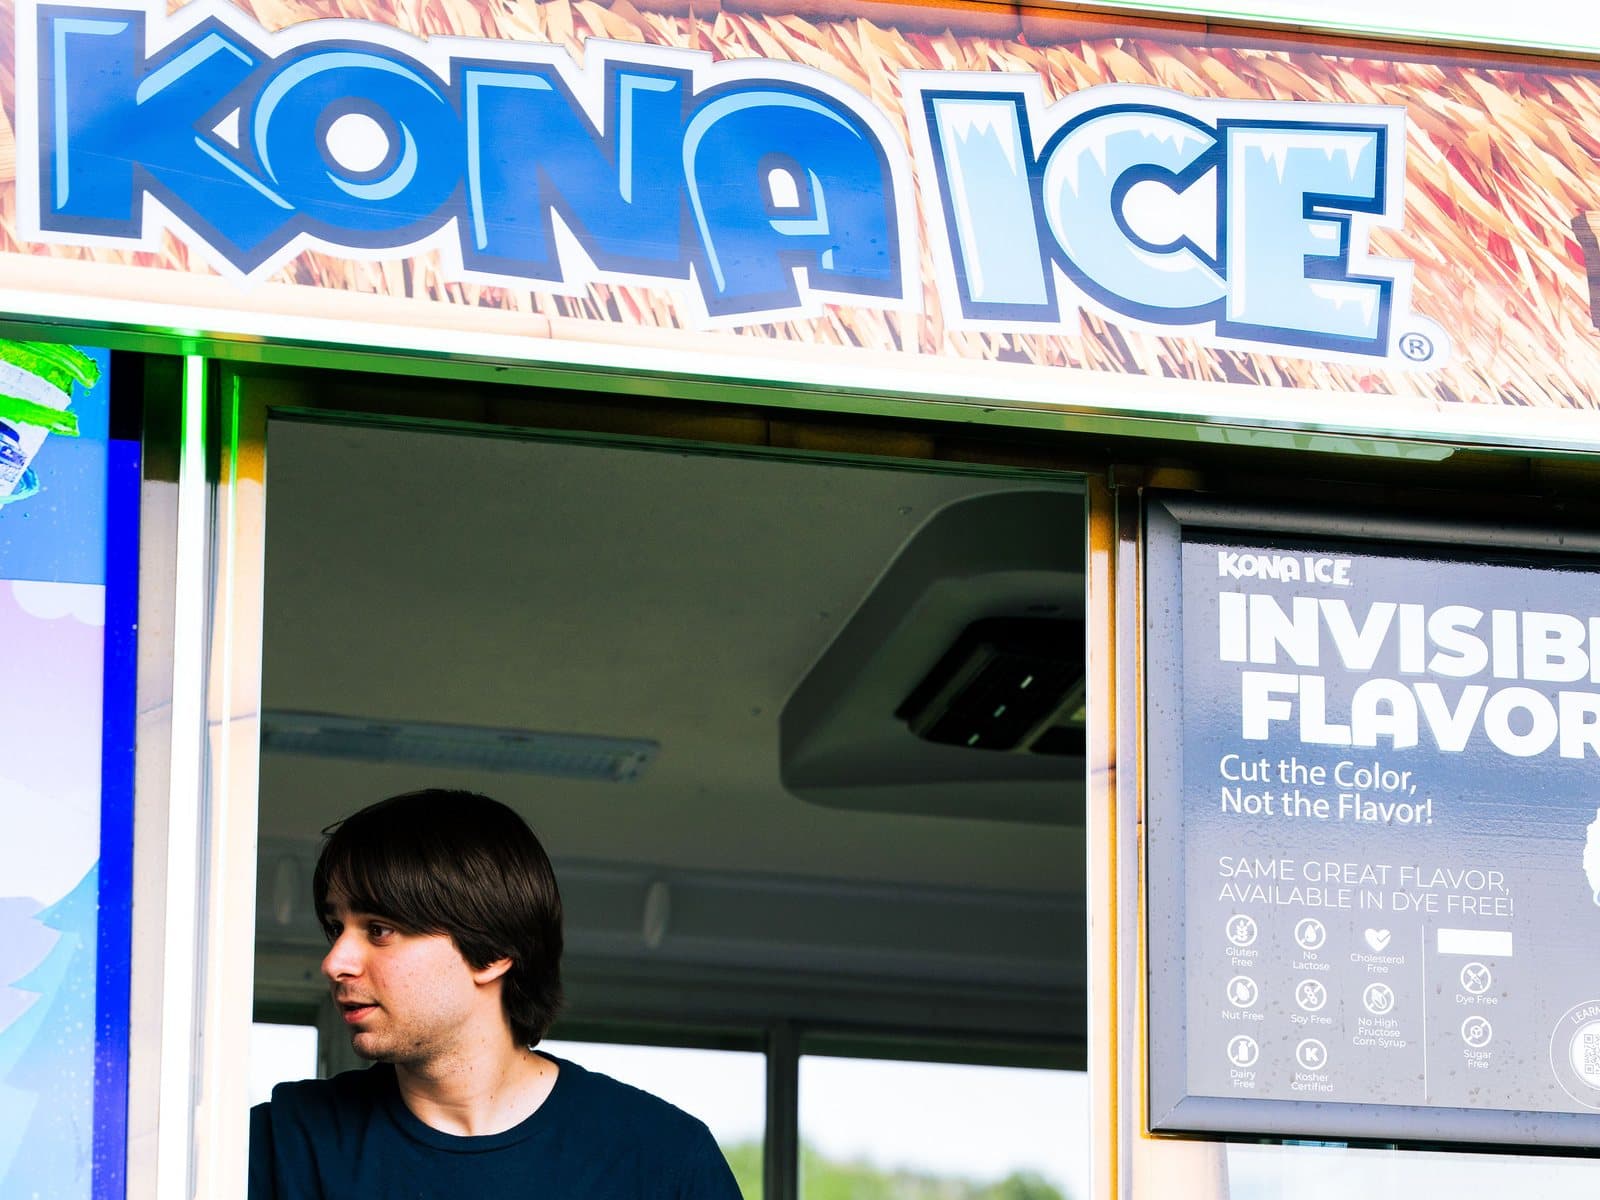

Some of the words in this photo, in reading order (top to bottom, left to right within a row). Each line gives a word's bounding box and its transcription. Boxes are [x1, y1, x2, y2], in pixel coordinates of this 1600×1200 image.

[35, 3, 904, 319] KONA
[921, 89, 1395, 358] ICE
[1218, 551, 1300, 582] KONA
[1304, 557, 1352, 585] ICE
[1219, 591, 1600, 683] INVISIB
[1220, 754, 1271, 783] Cut
[1278, 757, 1326, 786] the
[1334, 761, 1417, 795] Color,
[1221, 787, 1274, 816] Not
[1281, 790, 1329, 819] the
[1339, 793, 1433, 825] Flavor!
[1219, 856, 1295, 881] SAME
[1303, 861, 1392, 885] GREAT
[1400, 866, 1510, 894] FLAVOR,
[1218, 883, 1352, 909] AVAILABLE
[1360, 890, 1383, 910] IN
[1392, 892, 1439, 912] DYE
[1447, 895, 1514, 917] FREE!
[1225, 947, 1258, 958] Gluten
[1303, 951, 1318, 960] No
[1231, 957, 1253, 967] Free
[1350, 953, 1405, 965] Cholesterol
[1292, 961, 1330, 970] Lactose
[1367, 964, 1389, 973] Free
[1455, 995, 1475, 1005] Dye
[1477, 995, 1498, 1005] Free
[1222, 1010, 1241, 1020] Nut
[1243, 1011, 1264, 1021] Free
[1291, 1014, 1309, 1026] Soy
[1311, 1015, 1332, 1025] Free
[1358, 1017, 1372, 1026] No
[1375, 1018, 1398, 1029] High
[1358, 1027, 1401, 1037] Fructose
[1353, 1037, 1376, 1046] Corn
[1379, 1038, 1406, 1049] Syrup
[1464, 1050, 1492, 1060] Sugar
[1467, 1059, 1490, 1069] Free
[1230, 1070, 1256, 1080] Dairy
[1295, 1072, 1329, 1082] Kosher
[1233, 1079, 1255, 1088] Free
[1291, 1081, 1334, 1092] Certified
